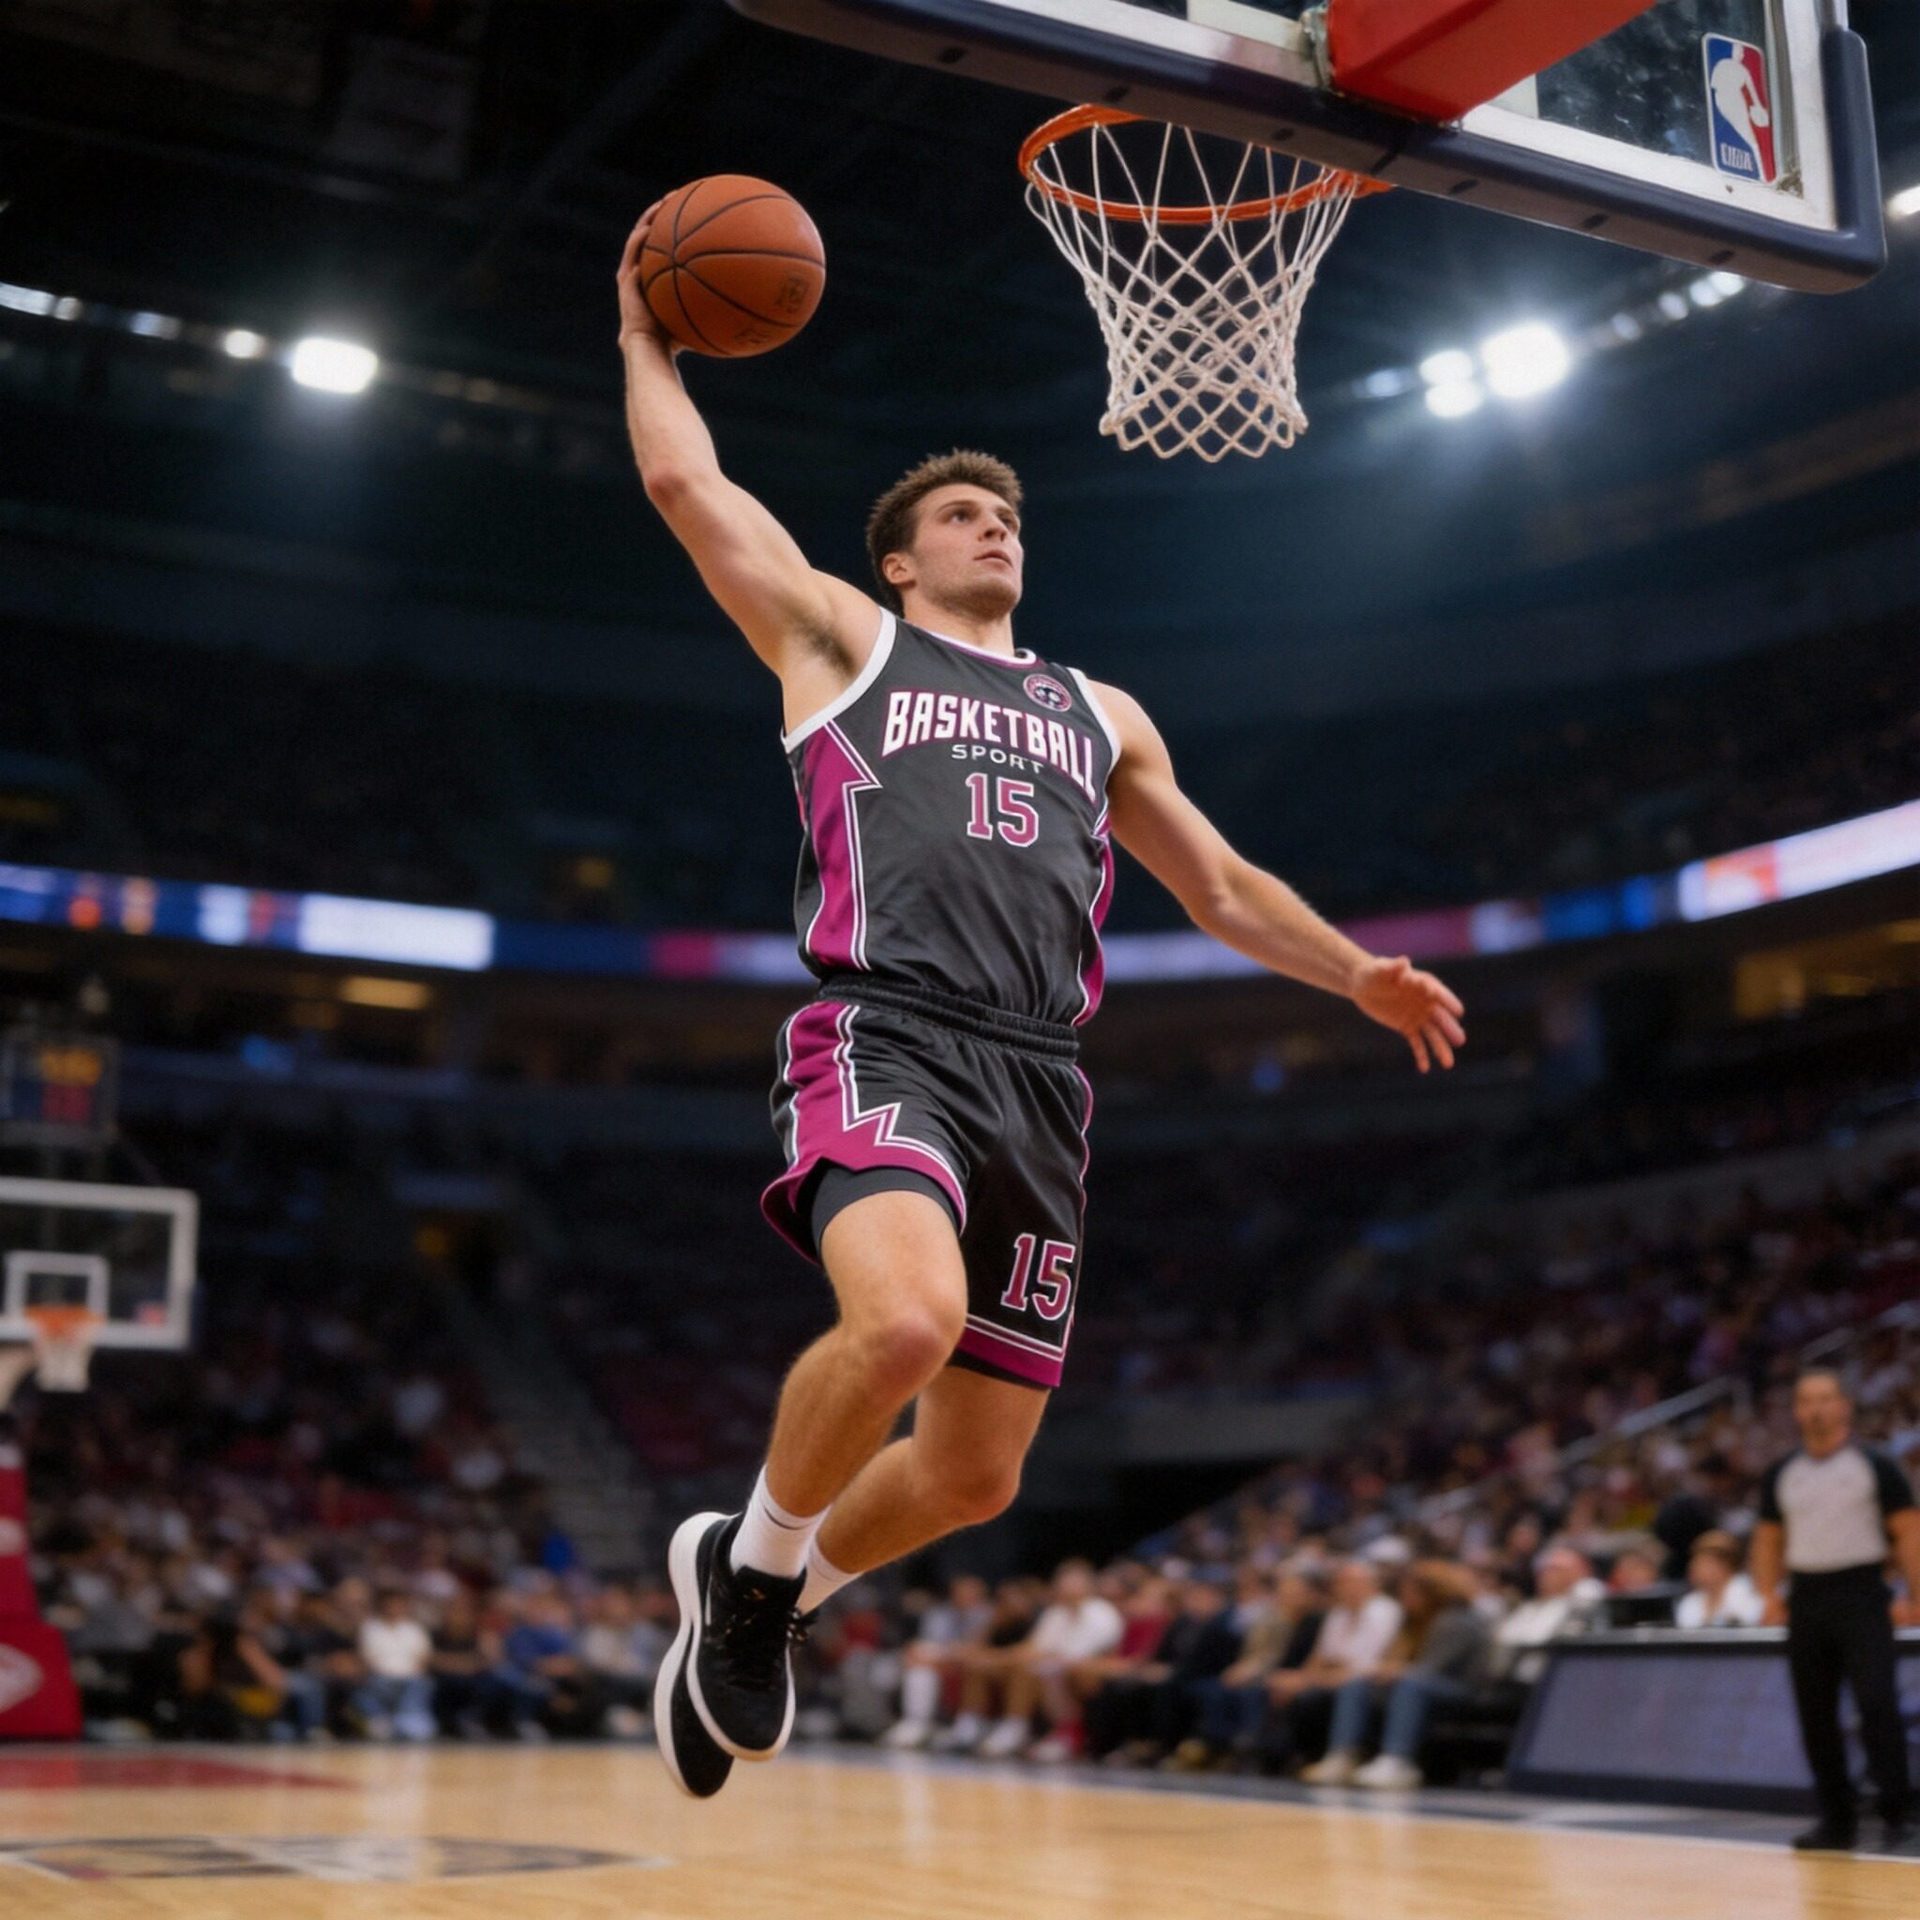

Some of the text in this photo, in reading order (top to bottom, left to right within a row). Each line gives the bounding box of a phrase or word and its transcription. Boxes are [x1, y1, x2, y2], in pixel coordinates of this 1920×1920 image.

[880, 689, 1098, 804] BASKETBALL
[951, 744, 1044, 774] SPORT
[965, 772, 1039, 848] 15
[1000, 1232, 1076, 1320] 15
